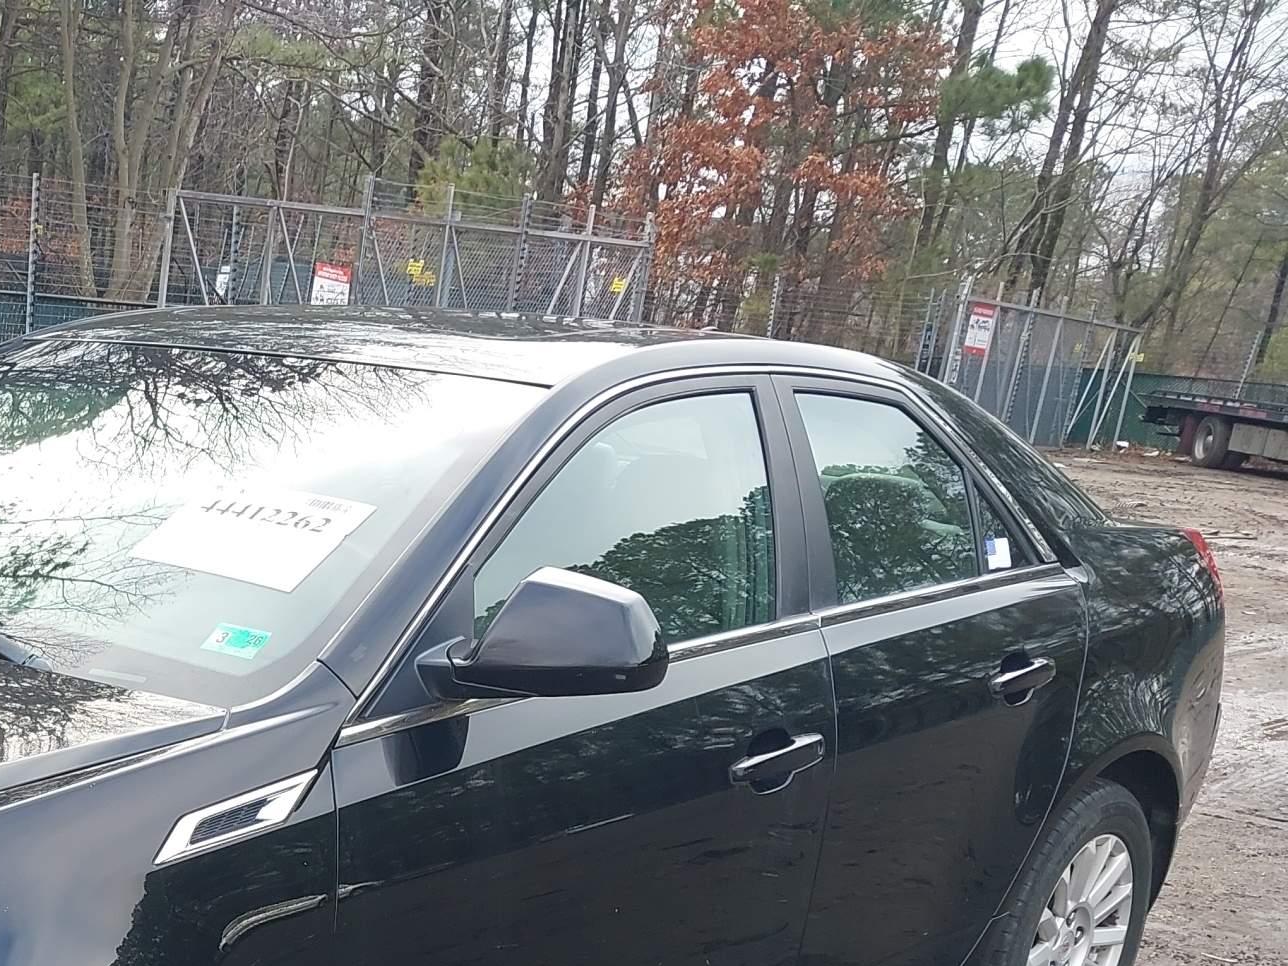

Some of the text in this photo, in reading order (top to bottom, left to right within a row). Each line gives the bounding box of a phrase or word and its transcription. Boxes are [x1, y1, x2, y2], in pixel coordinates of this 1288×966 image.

[200, 499, 332, 533] 44412262
[215, 631, 264, 647] 3 26
